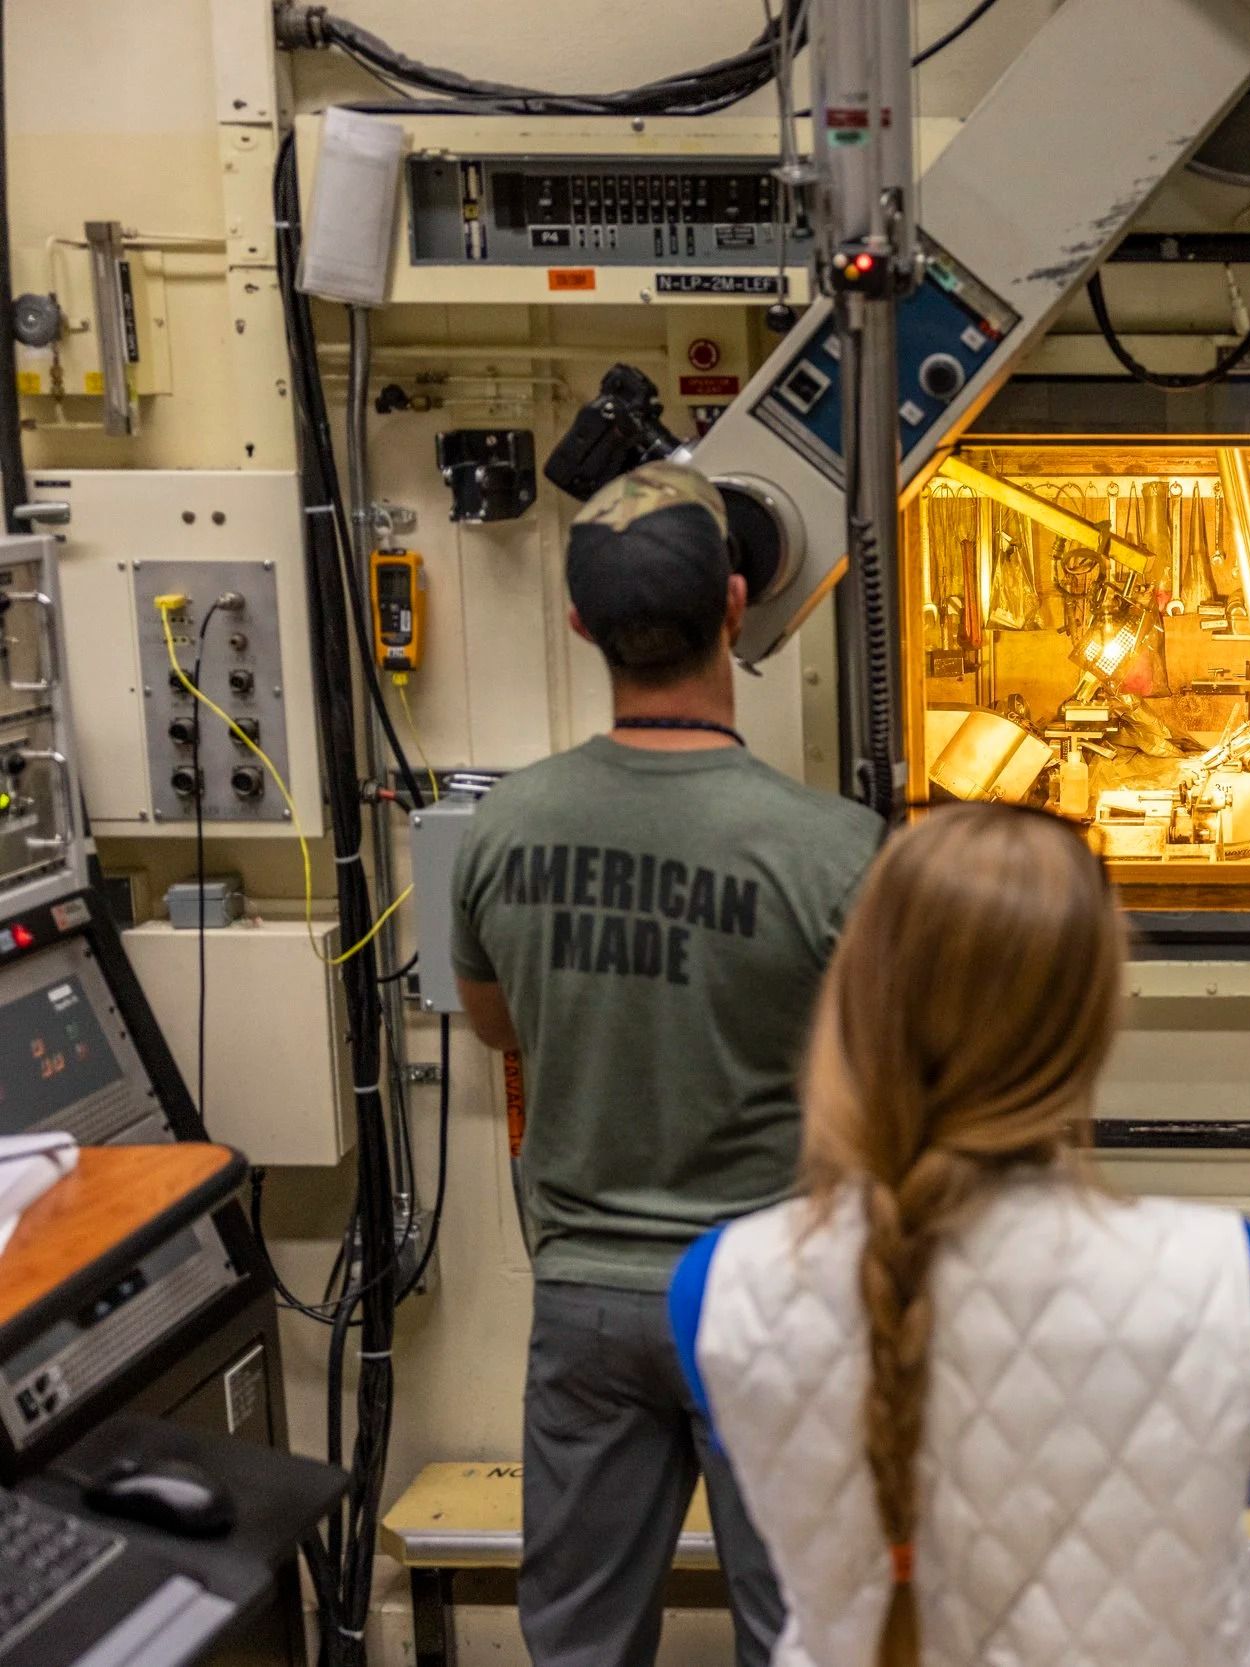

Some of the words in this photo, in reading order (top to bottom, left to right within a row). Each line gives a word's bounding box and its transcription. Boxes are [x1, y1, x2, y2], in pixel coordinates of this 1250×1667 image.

[541, 230, 560, 242] P4
[503, 844, 759, 939] AMERICAN
[551, 910, 690, 986] MADE
